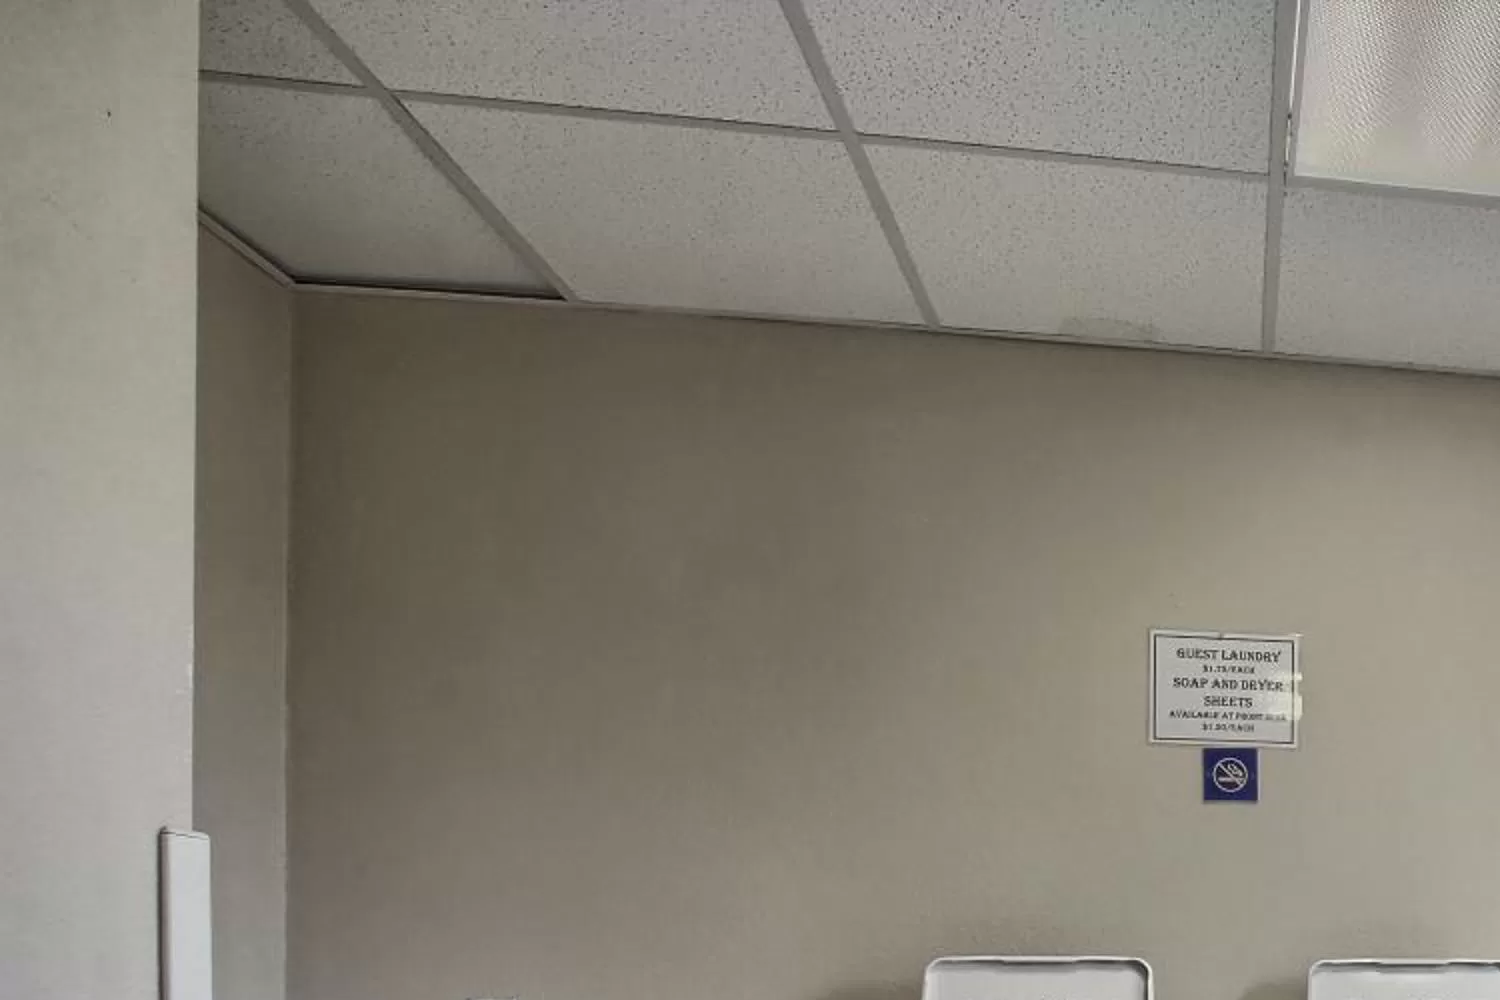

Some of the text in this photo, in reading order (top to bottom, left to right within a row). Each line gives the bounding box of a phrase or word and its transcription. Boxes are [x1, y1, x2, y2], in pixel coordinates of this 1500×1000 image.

[1176, 647, 1282, 662] GUEST LAUNDRY
[1173, 677, 1284, 691] SOAP AND DRYER
[1203, 695, 1253, 708] SHEETS
[1169, 711, 1218, 719] AVAILABLE
[1221, 712, 1233, 720] AT
